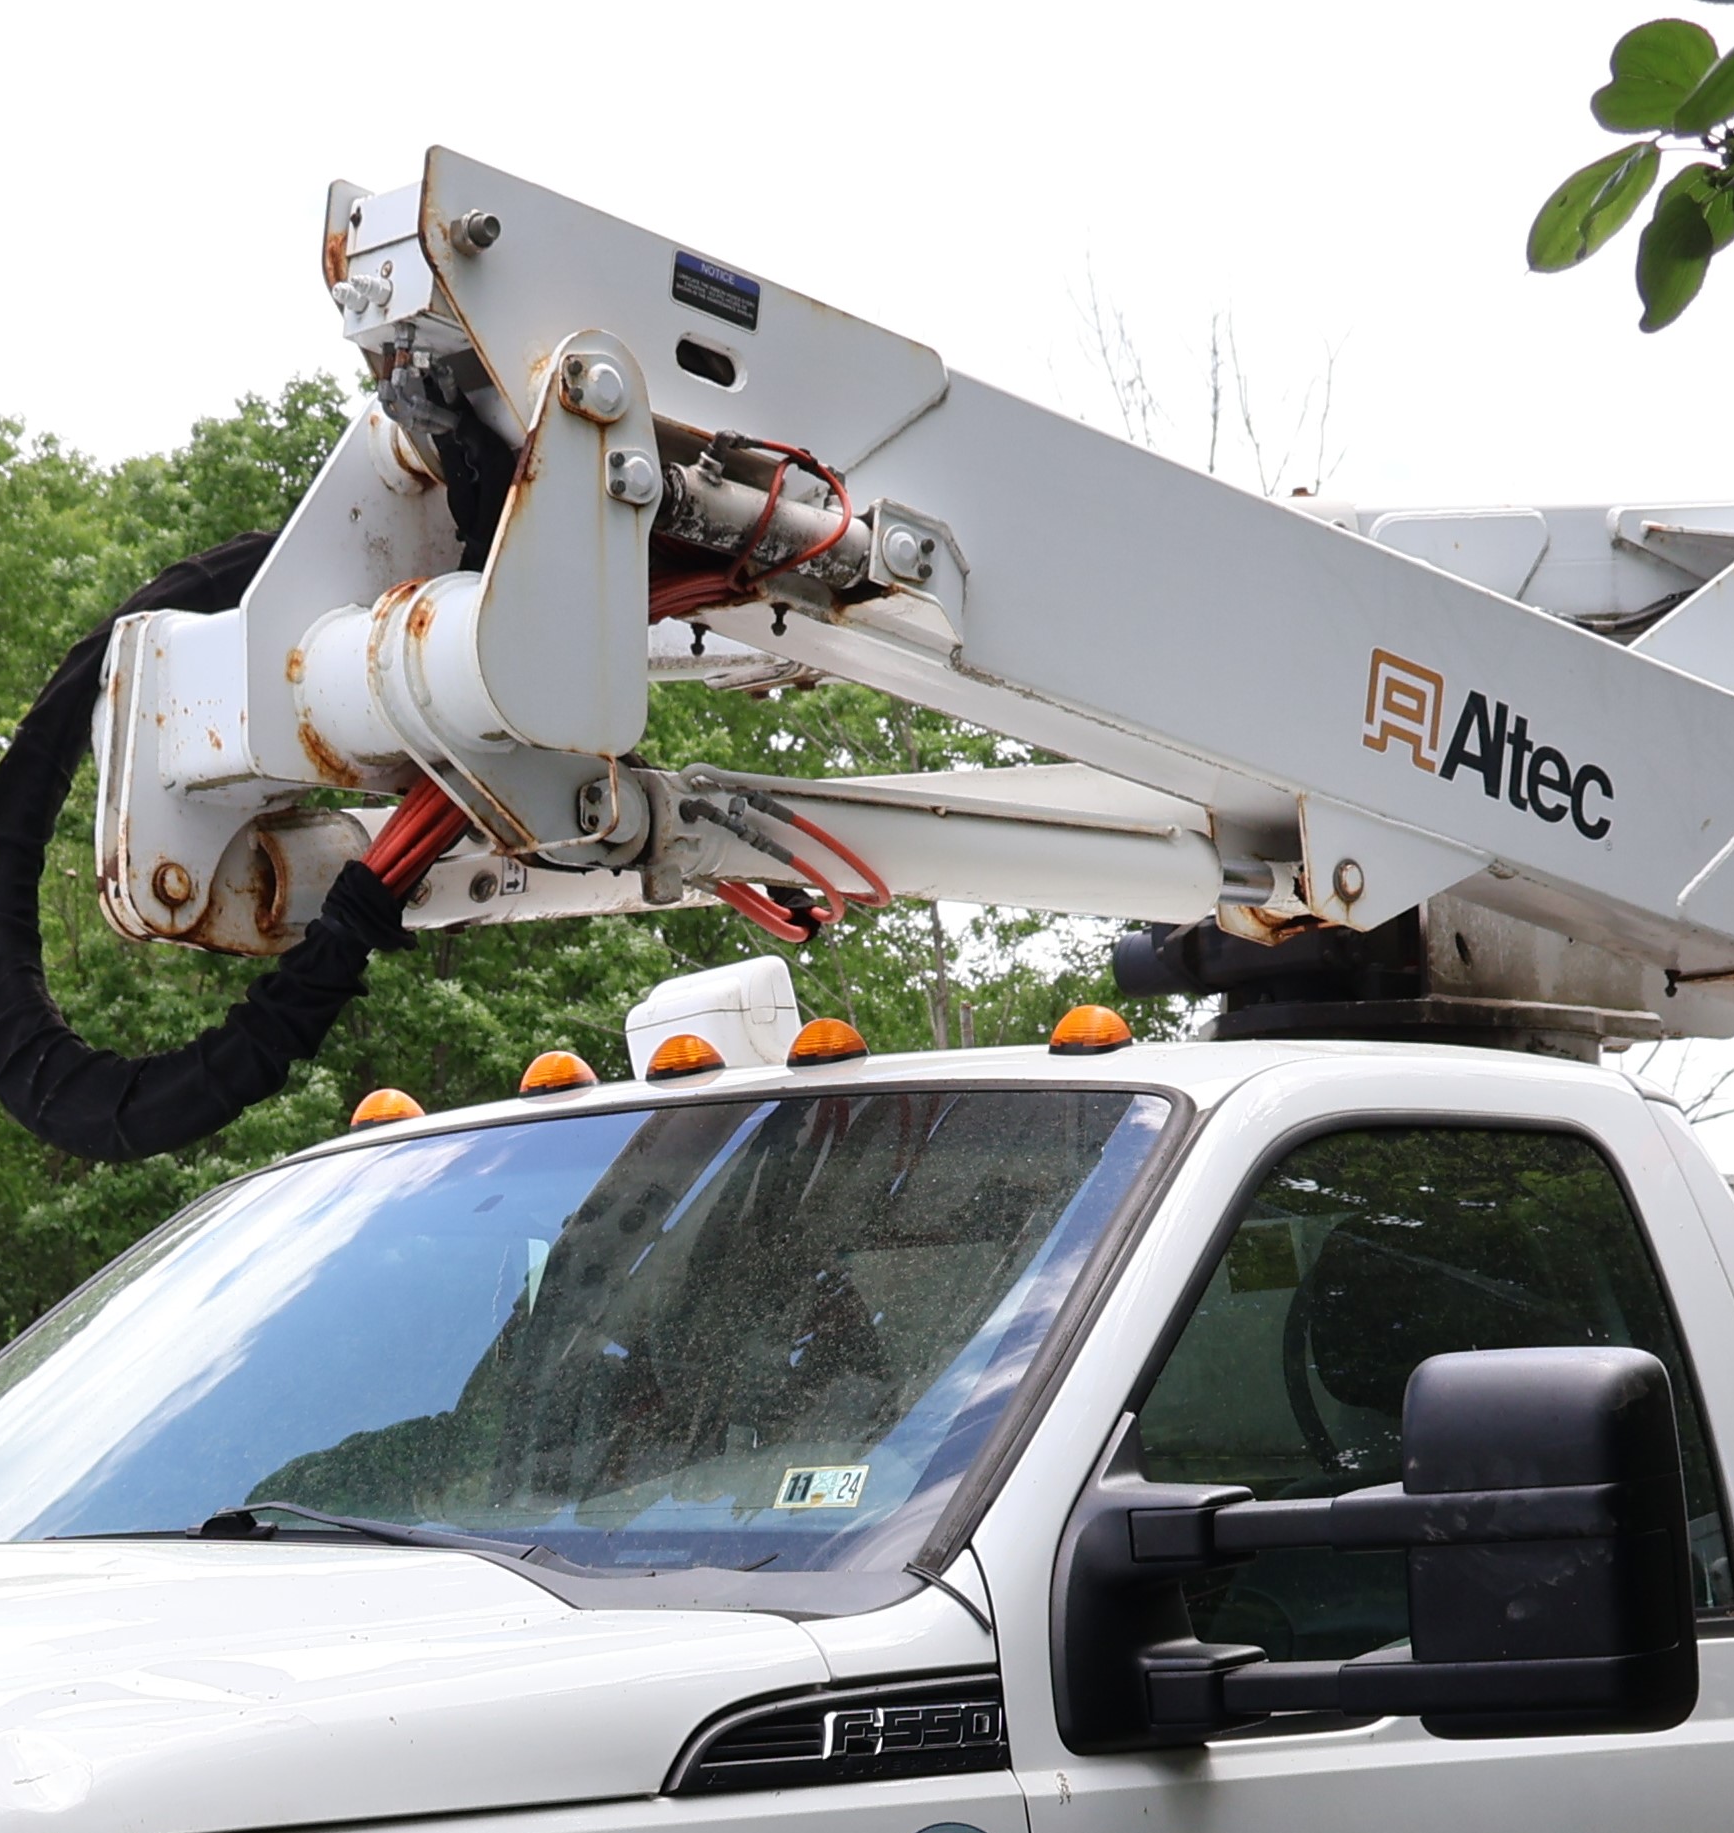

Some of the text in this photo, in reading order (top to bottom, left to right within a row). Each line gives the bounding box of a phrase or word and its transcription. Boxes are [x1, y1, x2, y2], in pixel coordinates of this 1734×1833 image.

[700, 262, 735, 285] NOTICE
[1439, 690, 1614, 841] Altec
[836, 1471, 862, 1500] 24
[822, 1701, 1004, 1761] F-550
